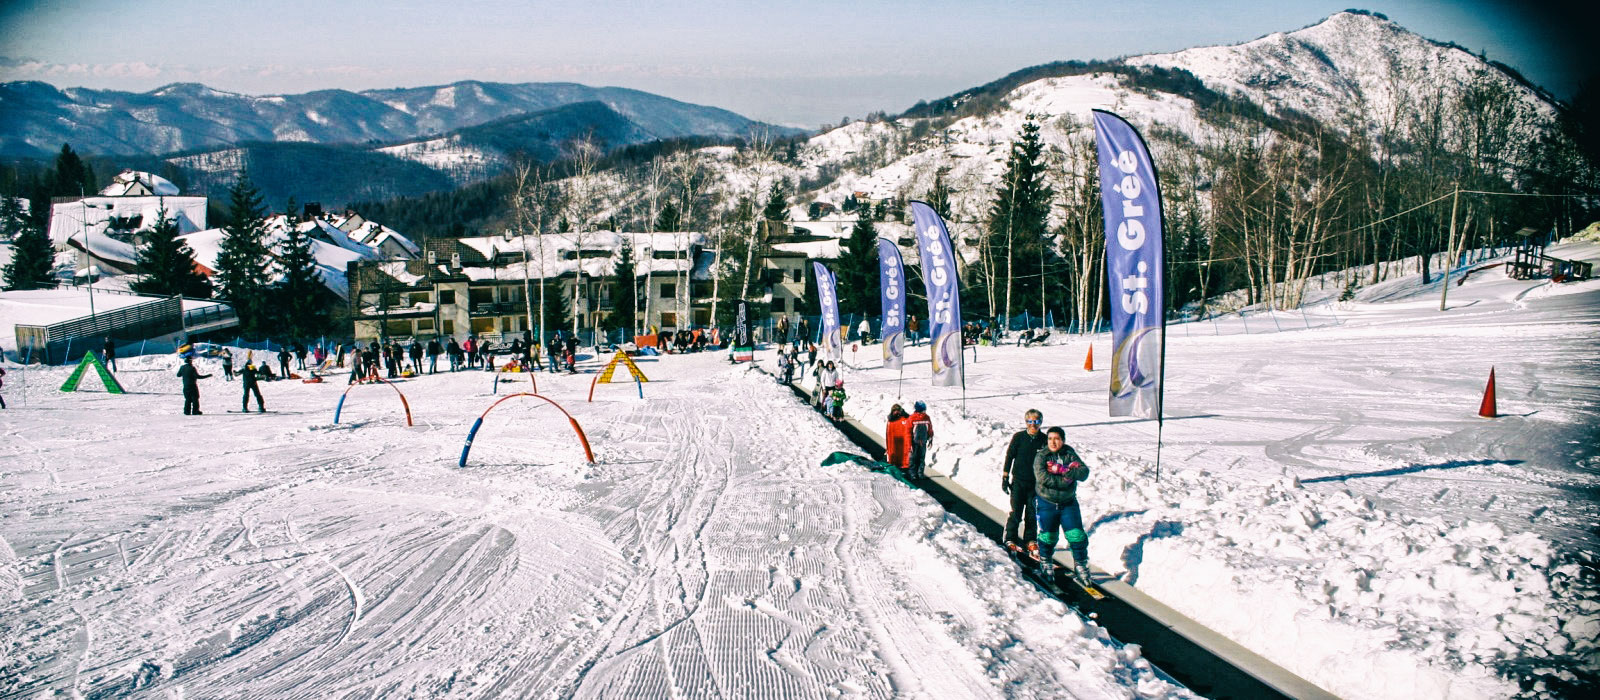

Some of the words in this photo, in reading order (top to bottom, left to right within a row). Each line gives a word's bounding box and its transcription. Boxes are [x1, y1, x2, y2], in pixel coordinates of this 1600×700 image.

[1110, 150, 1146, 251] Gréé
[885, 255, 898, 300] Gréé
[924, 225, 947, 287] Gréé
[935, 291, 950, 324] St.
[1122, 260, 1148, 315] St.
[887, 303, 899, 327] St.
